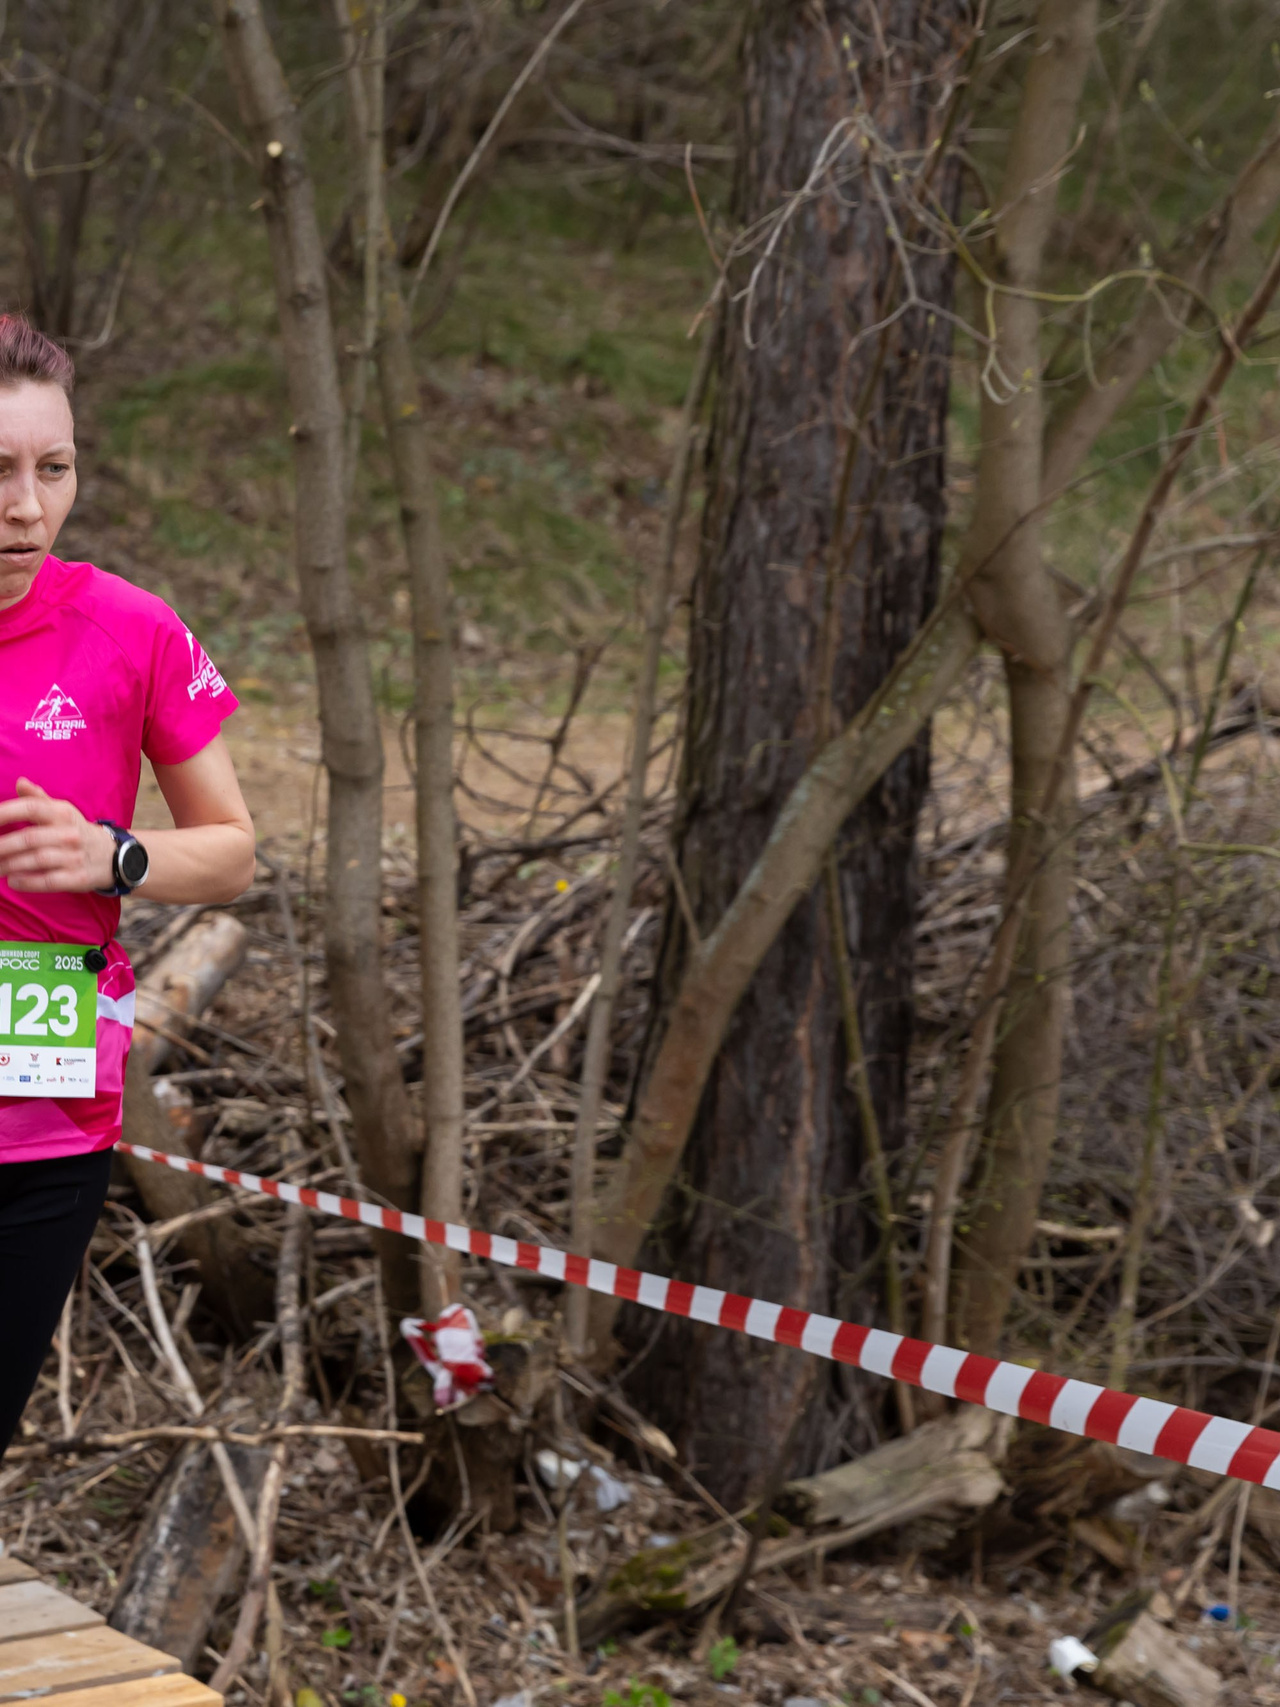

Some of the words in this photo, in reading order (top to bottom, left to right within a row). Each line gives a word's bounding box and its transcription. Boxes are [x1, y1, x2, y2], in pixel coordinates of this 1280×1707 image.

[25, 720, 53, 731] PRO
[54, 719, 87, 730] TRAIL
[42, 729, 71, 740] 365
[55, 955, 83, 971] 2025
